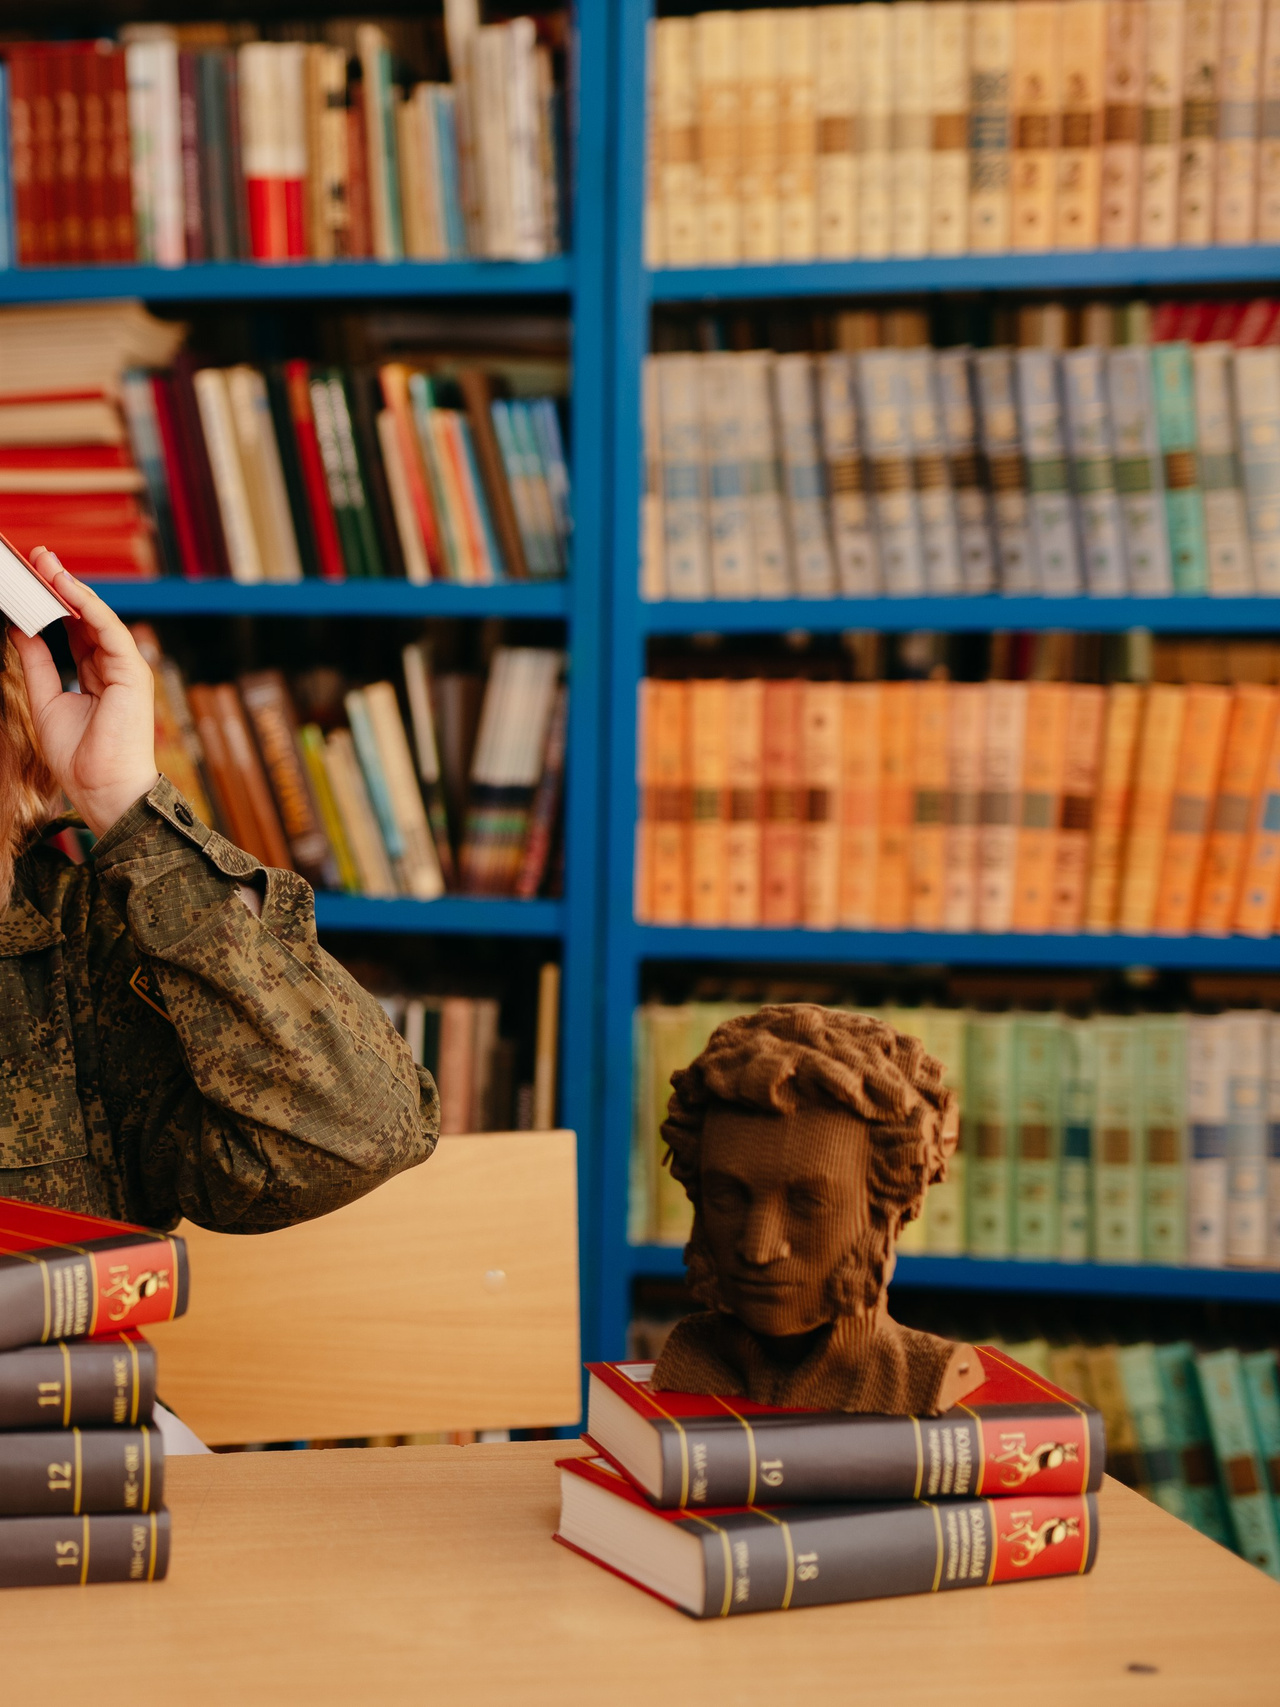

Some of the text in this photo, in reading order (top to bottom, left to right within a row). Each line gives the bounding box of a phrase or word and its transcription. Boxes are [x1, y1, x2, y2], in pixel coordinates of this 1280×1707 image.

[38, 1381, 61, 1407] 11
[760, 1458, 784, 1487] 19
[953, 1427, 971, 1494] БОЛЬШАЯ
[47, 1461, 72, 1492] 12
[55, 1540, 80, 1568] 15
[969, 1508, 986, 1578] БОЛЬШАЯ
[797, 1552, 819, 1582] 18
